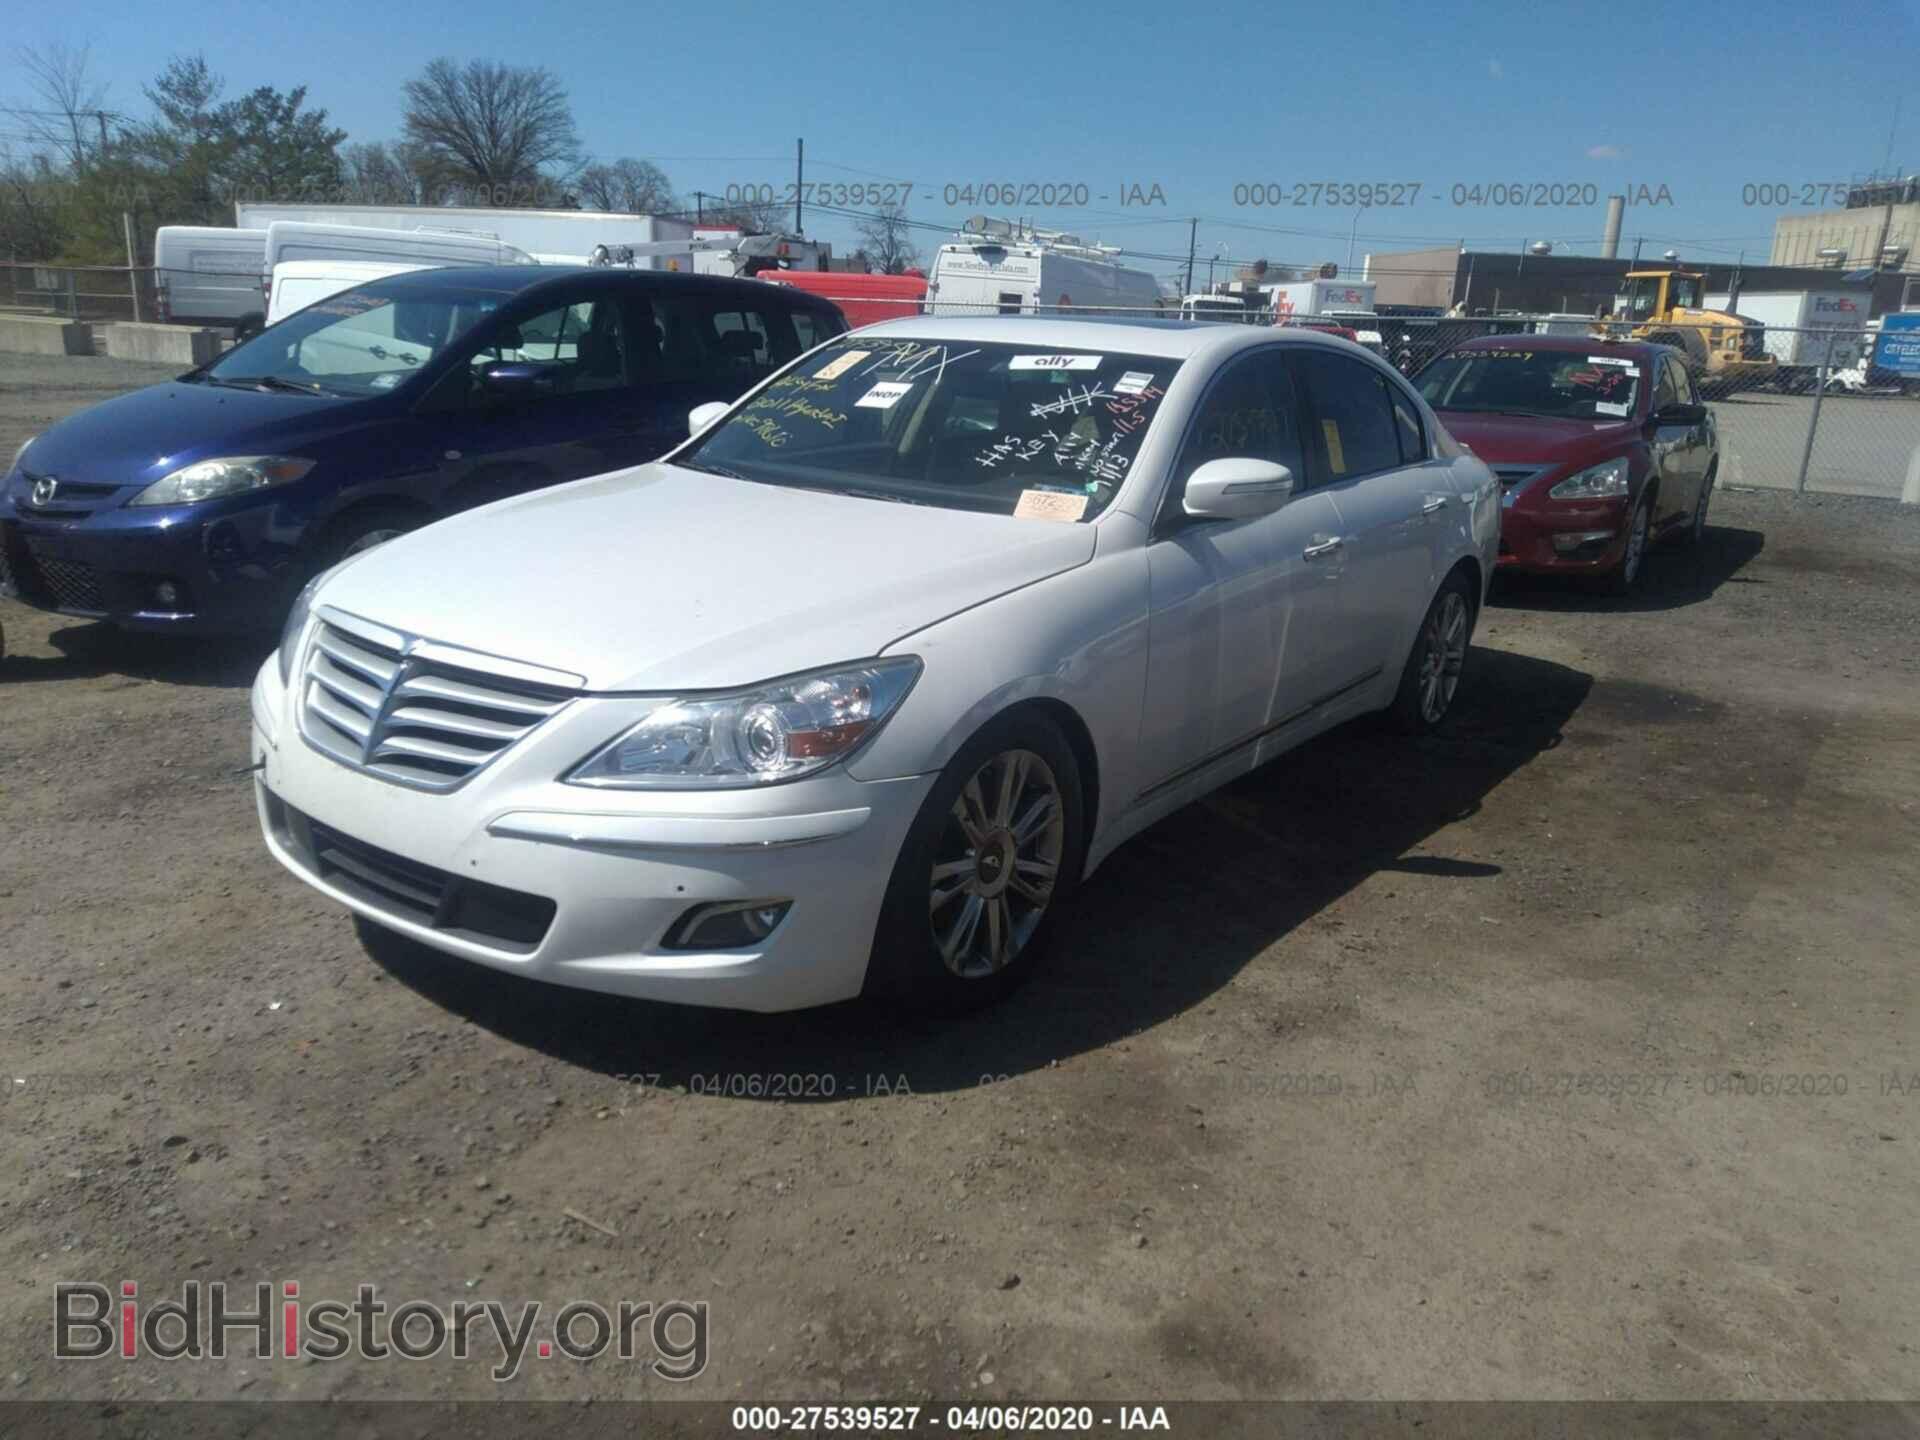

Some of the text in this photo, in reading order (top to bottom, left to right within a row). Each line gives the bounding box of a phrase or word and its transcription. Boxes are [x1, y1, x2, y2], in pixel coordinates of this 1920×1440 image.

[1325, 288, 1362, 304] FedEx
[1815, 297, 1857, 313] FedEx
[1034, 356, 1075, 368] ally
[976, 435, 1022, 468] HAS
[1015, 429, 1060, 462] KEY
